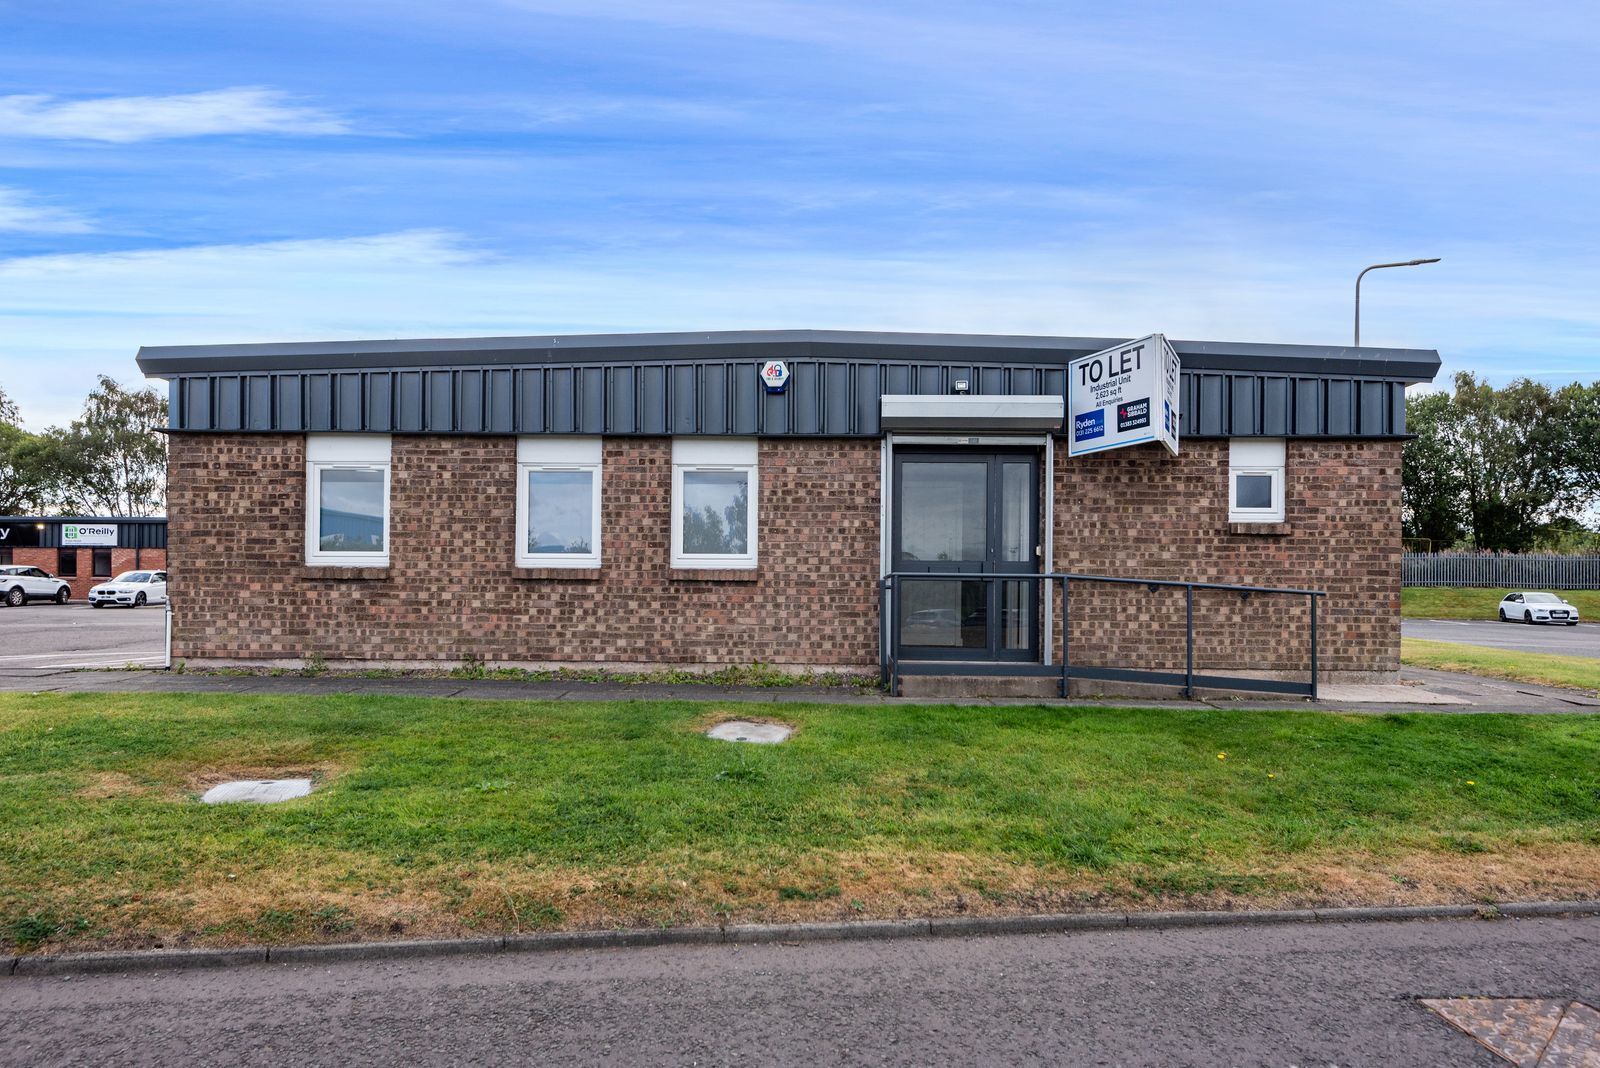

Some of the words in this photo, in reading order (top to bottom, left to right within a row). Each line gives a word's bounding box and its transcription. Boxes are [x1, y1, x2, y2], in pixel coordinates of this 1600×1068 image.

[1078, 359, 1103, 386] TO
[1109, 344, 1145, 378] LET
[1090, 379, 1117, 393] Industrial
[1118, 374, 1131, 385] Unit
[1095, 389, 1109, 400] 2,623
[1109, 388, 1117, 396] sq
[1117, 386, 1122, 394] ft
[1102, 397, 1124, 407] Enquiries
[1126, 402, 1148, 412] GRAHAM
[1075, 418, 1096, 430] Ryden
[1085, 427, 1093, 435] 225
[78, 527, 115, 536] O'Reilly
